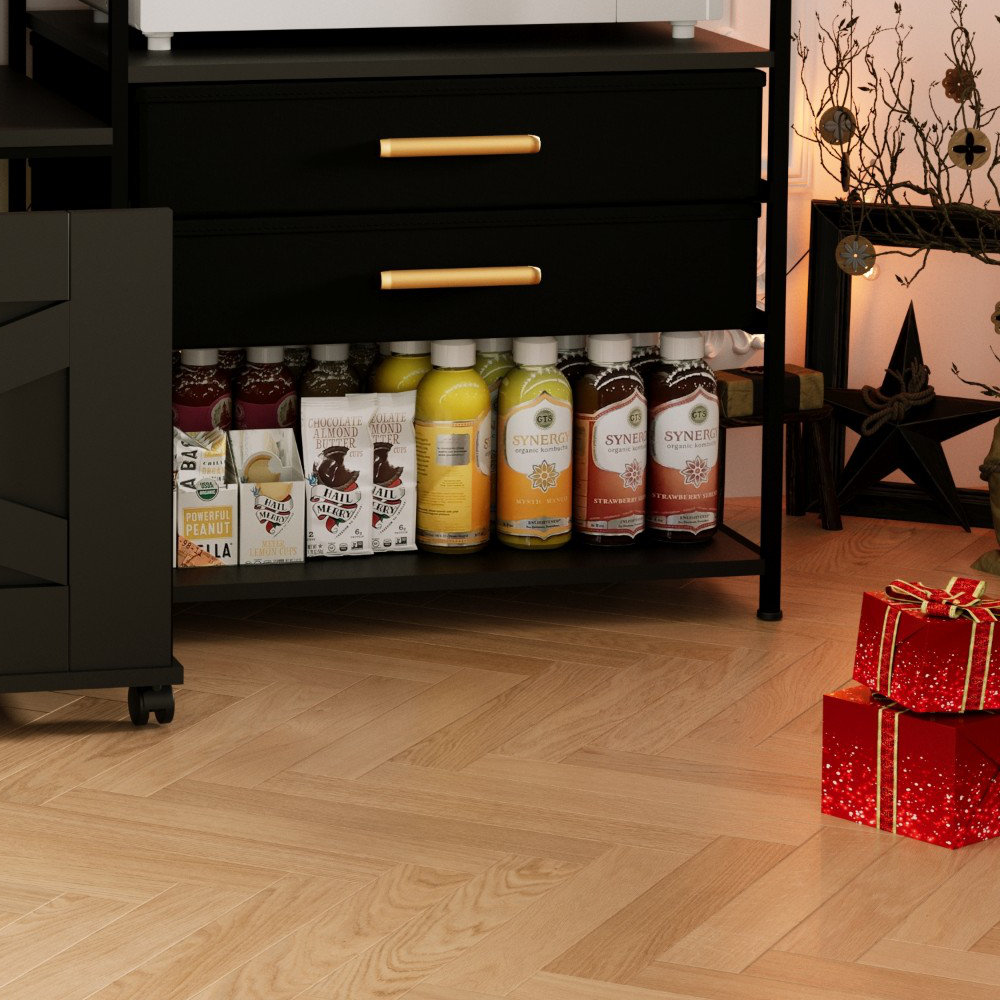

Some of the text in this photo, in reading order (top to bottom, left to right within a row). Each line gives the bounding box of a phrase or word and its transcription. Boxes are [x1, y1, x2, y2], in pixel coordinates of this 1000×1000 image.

[308, 416, 363, 429] CHOCOLATE
[313, 427, 358, 439] ALMOND
[371, 423, 402, 435] MOND
[316, 438, 356, 449] BUTTER
[372, 434, 400, 445] TTER
[323, 488, 353, 504] HAIL
[651, 492, 700, 500] STRAWBERRY
[264, 498, 287, 511] HAIL
[186, 510, 230, 522] POWERFUL
[259, 511, 286, 523] MERRY
[316, 504, 352, 519] MERRY
[186, 521, 230, 537] PEANUT
[249, 547, 276, 556] LEMON
